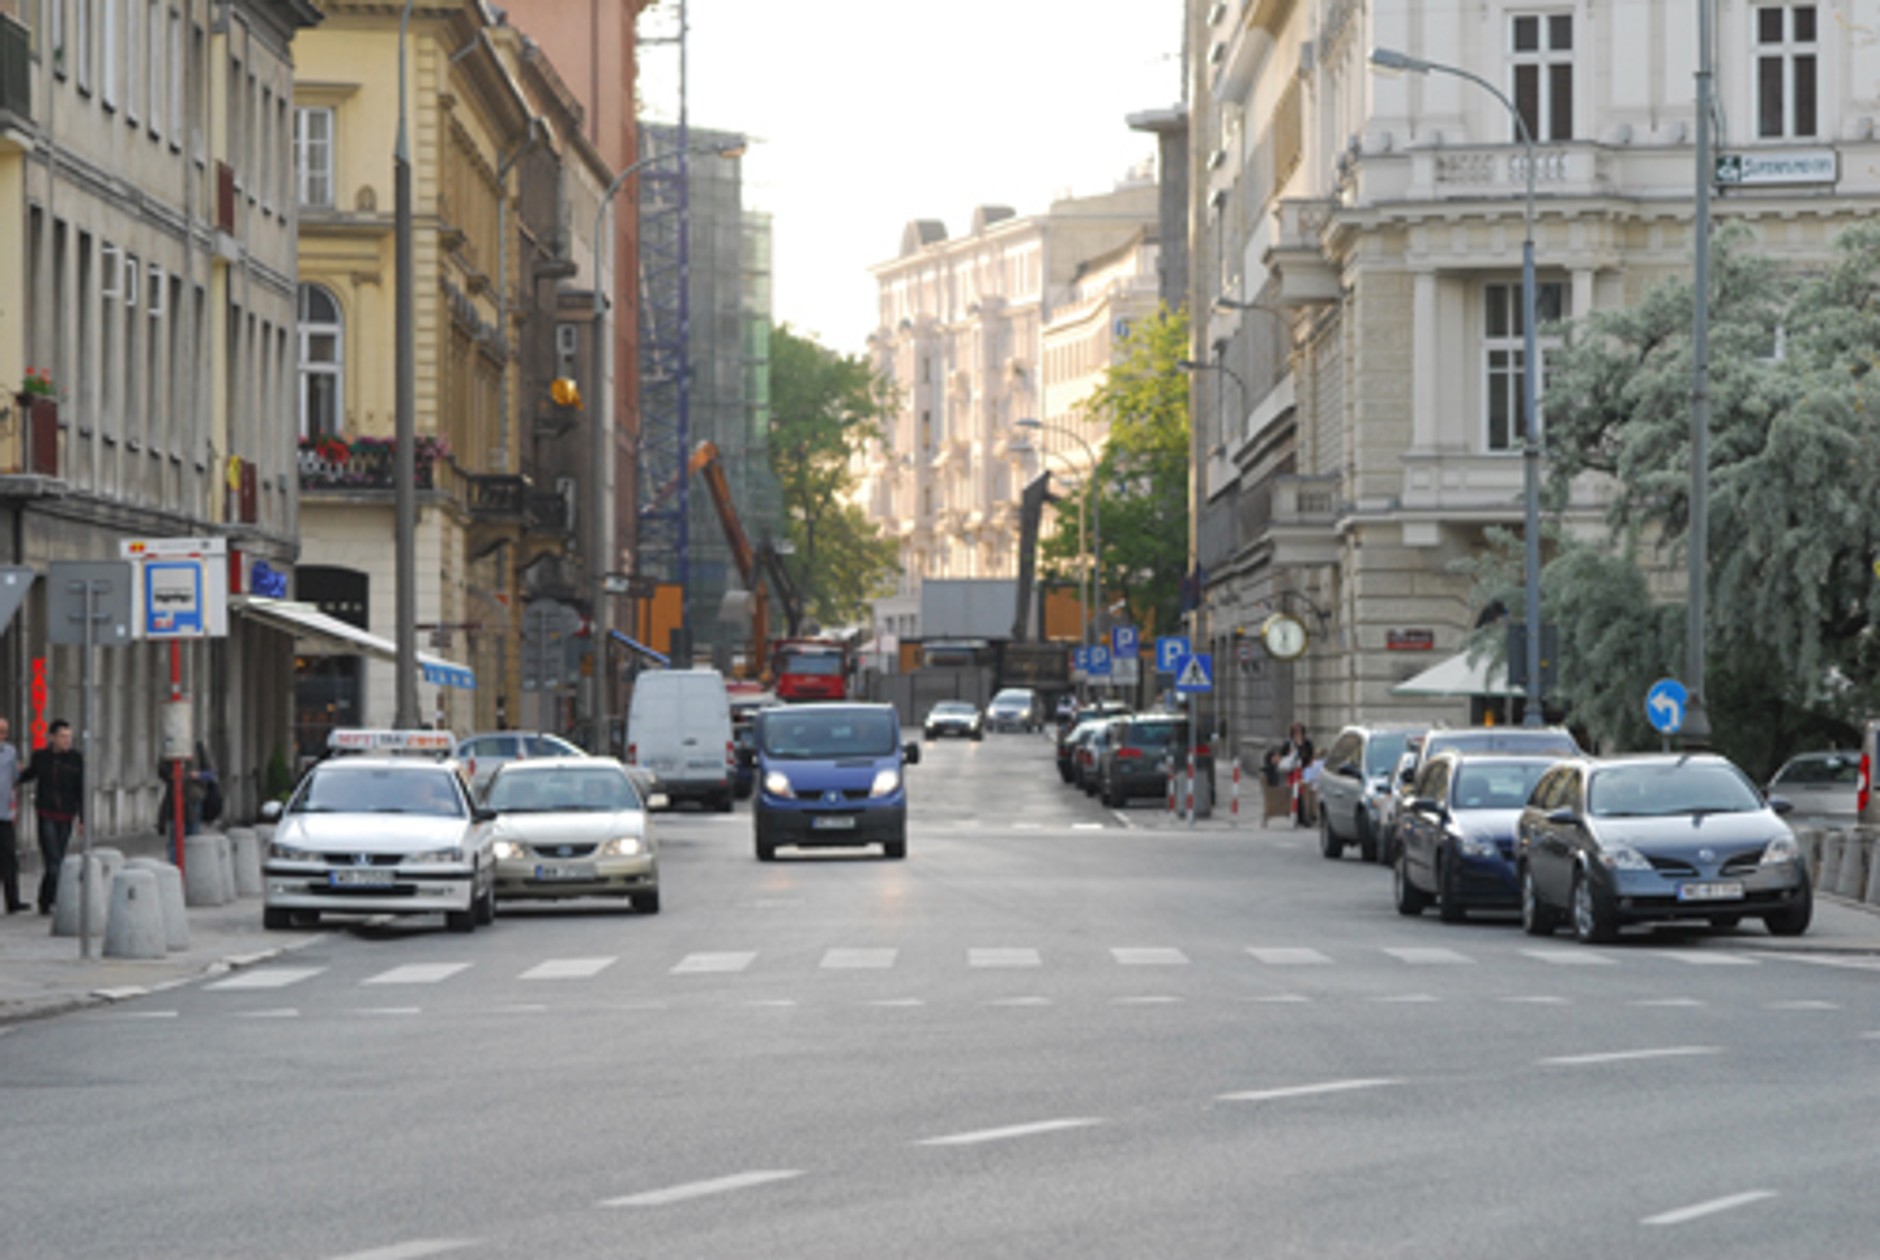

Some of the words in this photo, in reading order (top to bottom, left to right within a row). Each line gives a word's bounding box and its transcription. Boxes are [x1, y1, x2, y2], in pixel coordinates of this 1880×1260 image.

[1119, 629, 1133, 647] P
[1091, 647, 1106, 666] P
[1164, 641, 1183, 667] P
[31, 657, 47, 750] KANTOR
